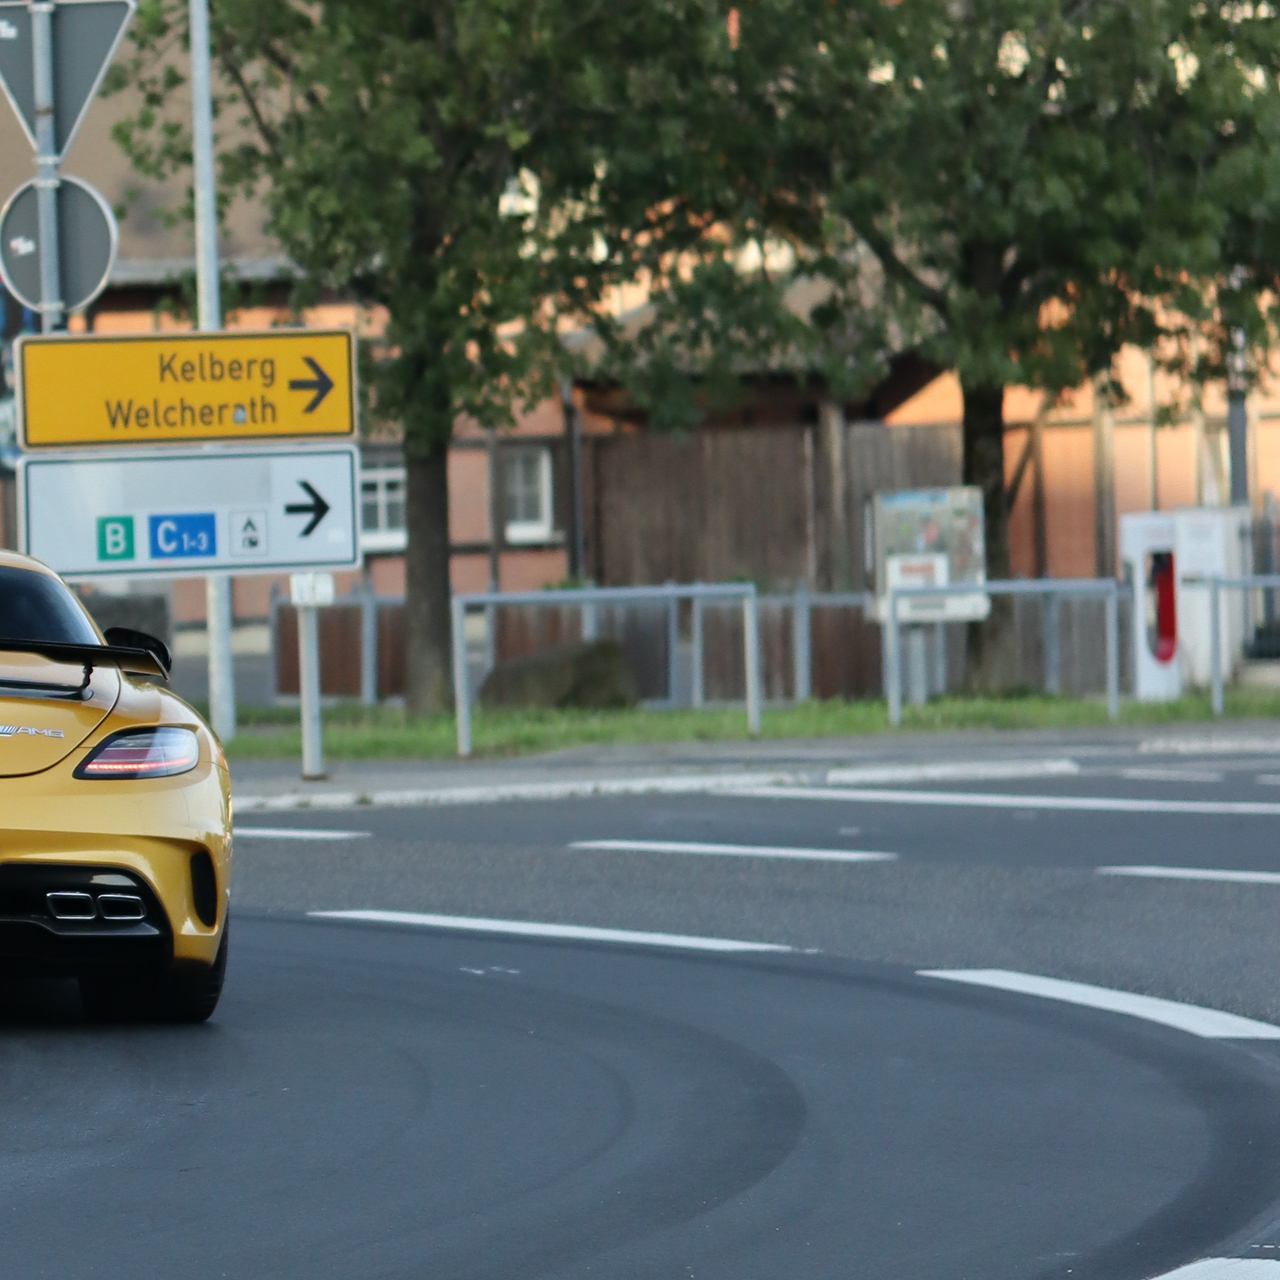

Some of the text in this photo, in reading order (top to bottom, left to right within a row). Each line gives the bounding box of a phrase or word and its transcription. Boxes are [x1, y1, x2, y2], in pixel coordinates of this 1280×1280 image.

[159, 352, 276, 387] Kelberg
[105, 523, 126, 555] B
[16, 725, 64, 738] AMG
